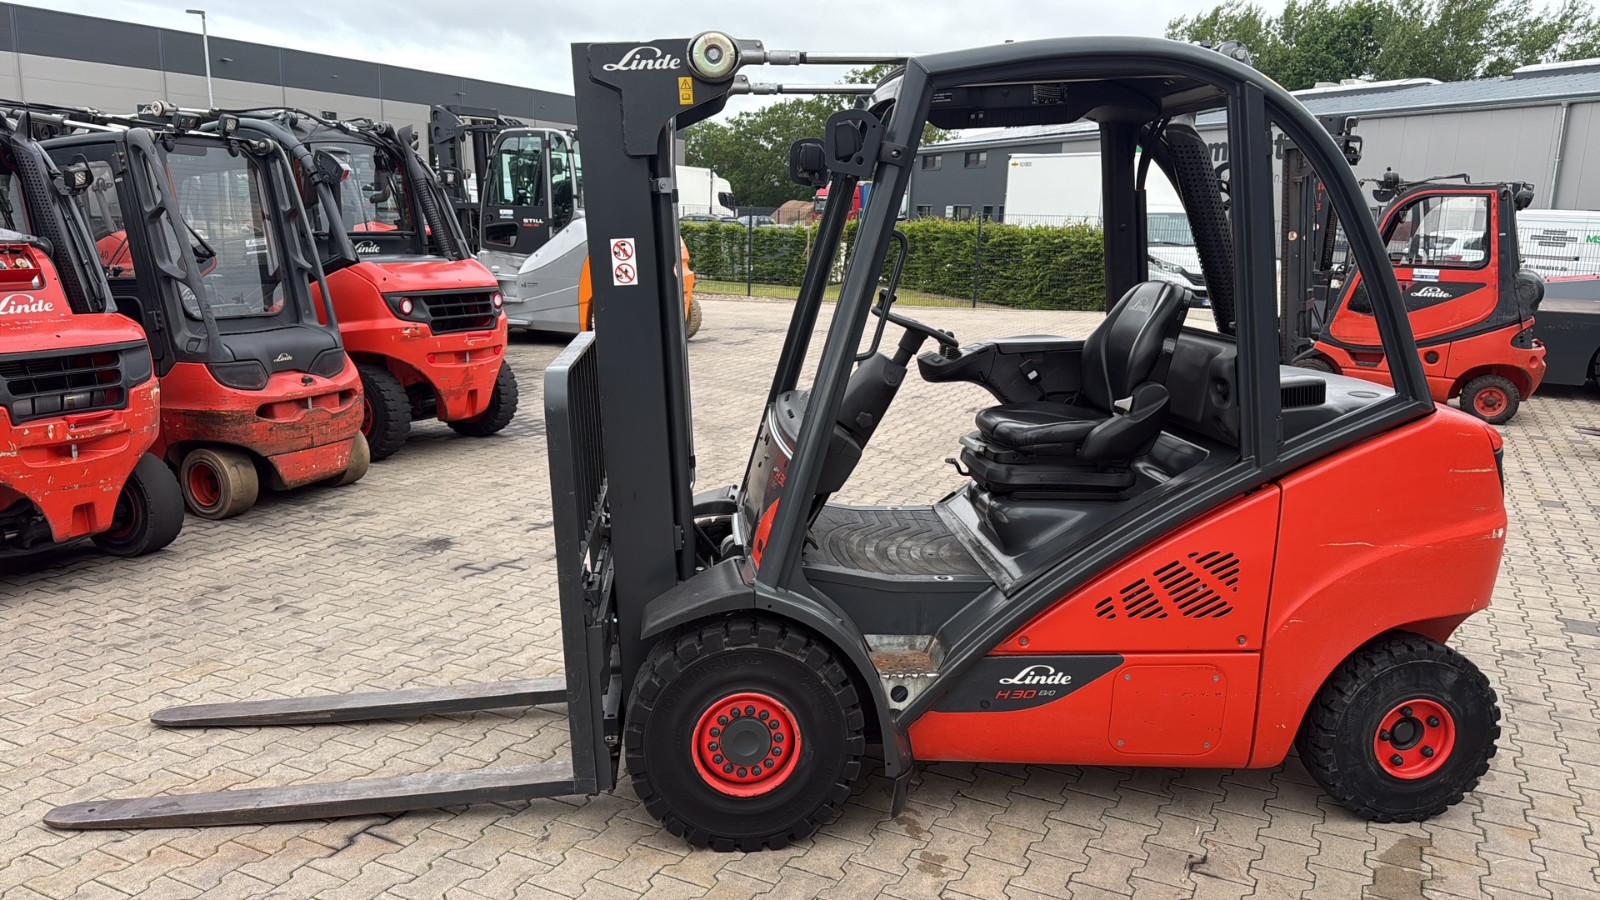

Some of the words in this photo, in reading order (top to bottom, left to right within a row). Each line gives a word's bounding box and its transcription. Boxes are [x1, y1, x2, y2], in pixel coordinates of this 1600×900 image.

[603, 46, 681, 71] Linde
[1410, 286, 1451, 298] Linde
[0, 293, 55, 315] Linde
[273, 352, 293, 362] Linde
[999, 664, 1072, 685] Linde
